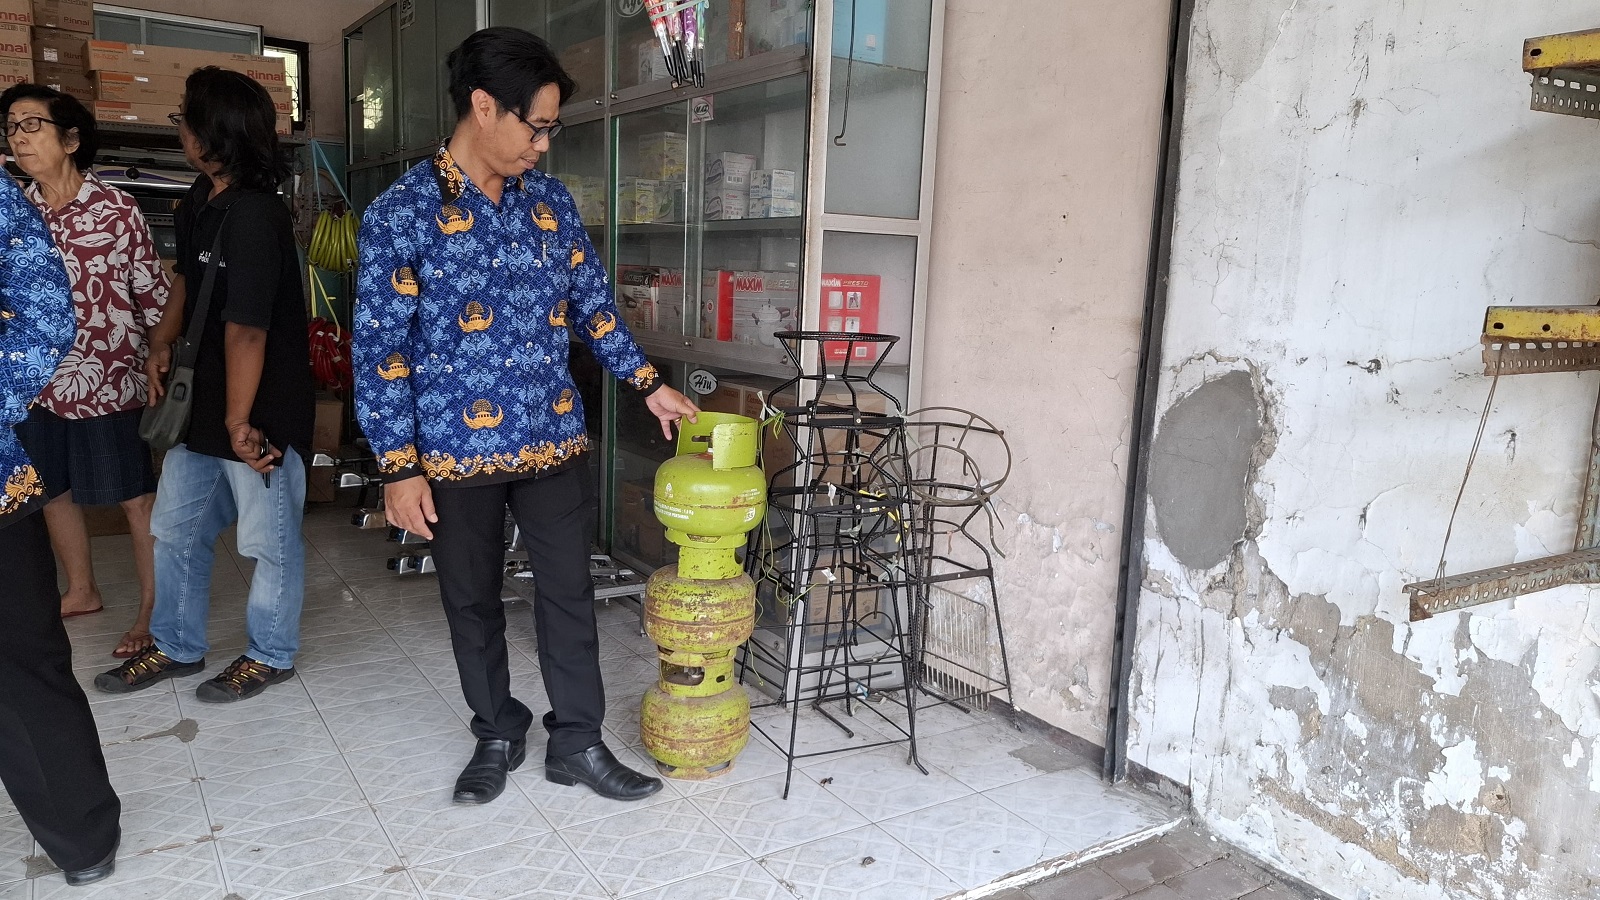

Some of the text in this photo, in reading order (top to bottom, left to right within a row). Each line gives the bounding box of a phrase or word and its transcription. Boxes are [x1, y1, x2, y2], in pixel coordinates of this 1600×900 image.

[0, 11, 31, 22] nnai
[63, 16, 90, 27] Rinnai
[63, 51, 84, 61] Rinn
[0, 74, 29, 83] nnai
[246, 69, 284, 82] Rinnai
[735, 275, 798, 293] MAXIM PREST
[693, 374, 712, 390] Hiu
